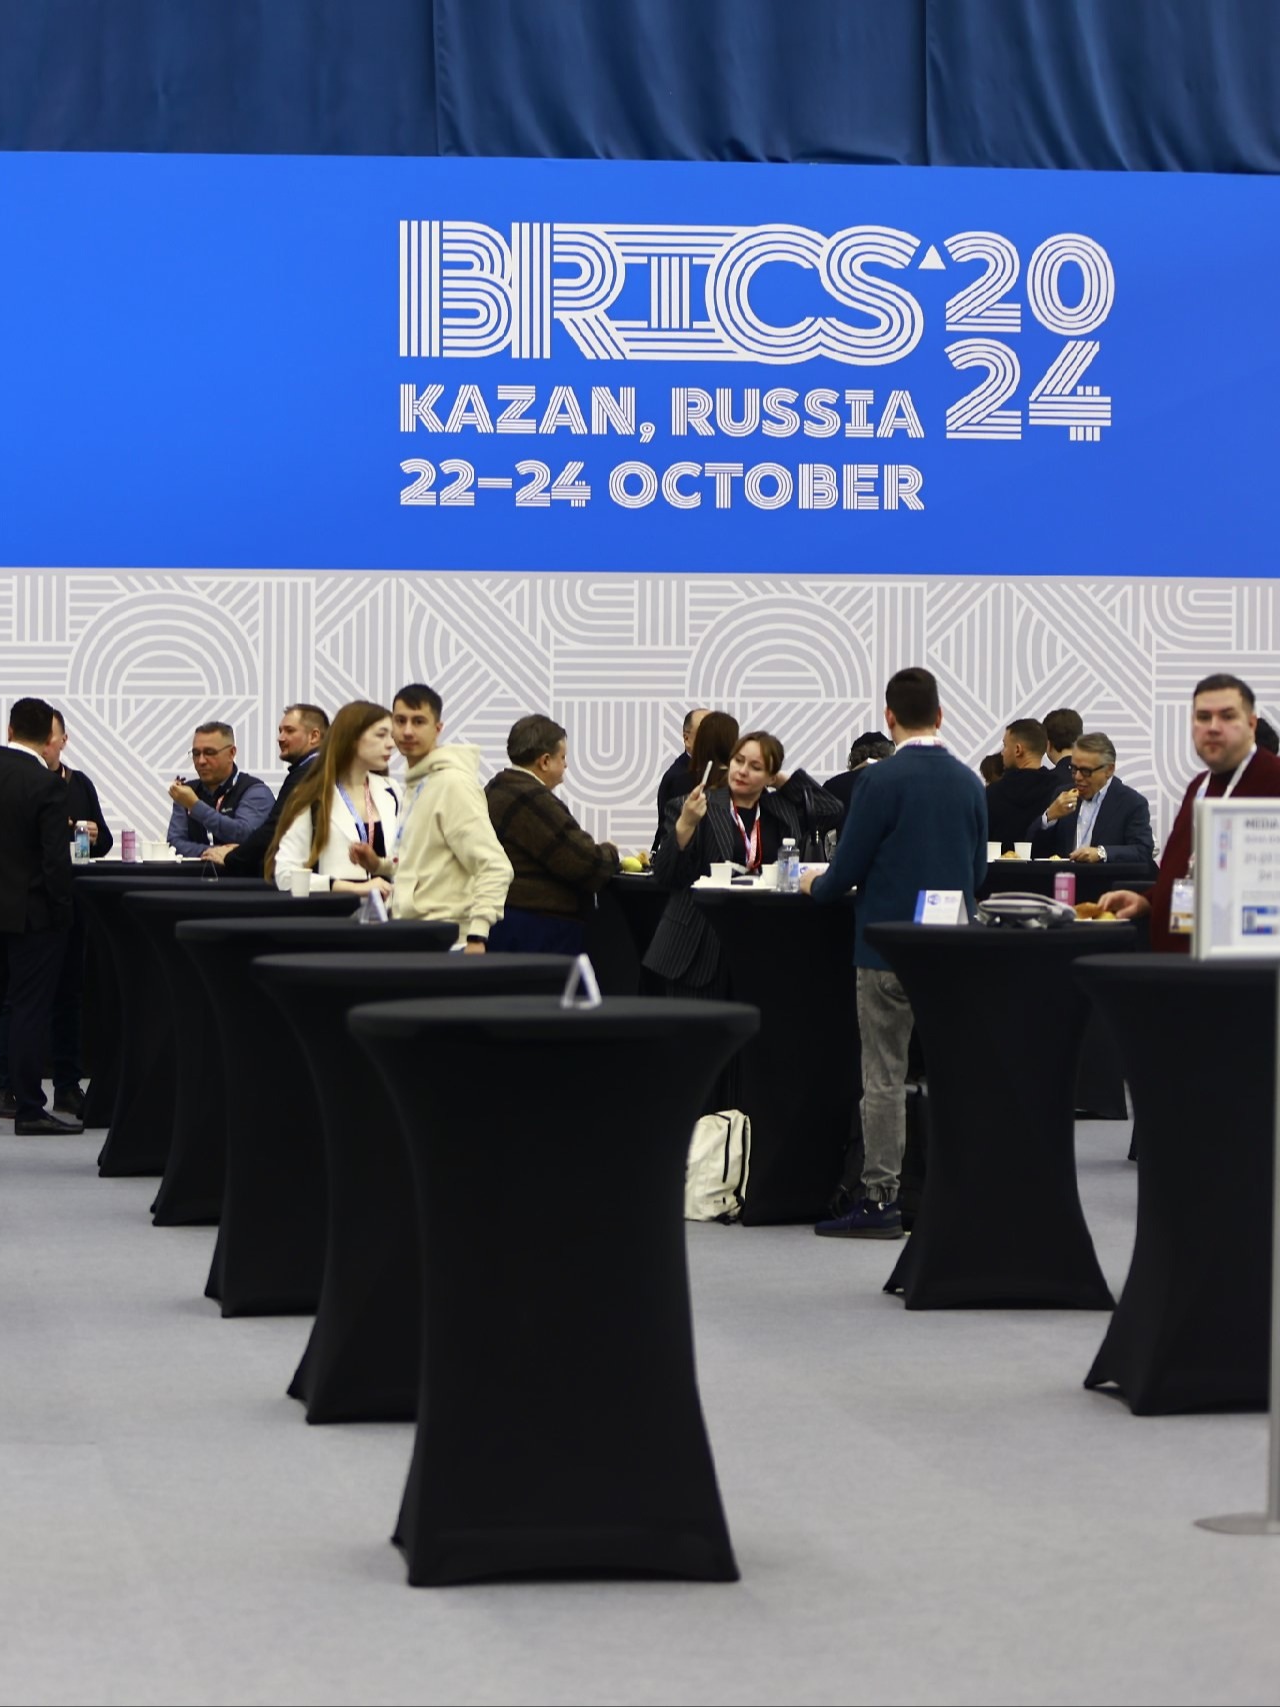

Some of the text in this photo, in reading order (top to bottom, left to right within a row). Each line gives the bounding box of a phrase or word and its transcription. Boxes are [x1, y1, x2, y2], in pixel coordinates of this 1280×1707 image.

[400, 220, 924, 367] BRICS
[944, 231, 1116, 335] 20
[400, 384, 926, 443] KAZAN, RUSSIA
[944, 338, 1112, 442] 24
[609, 461, 925, 511] OCTOBER
